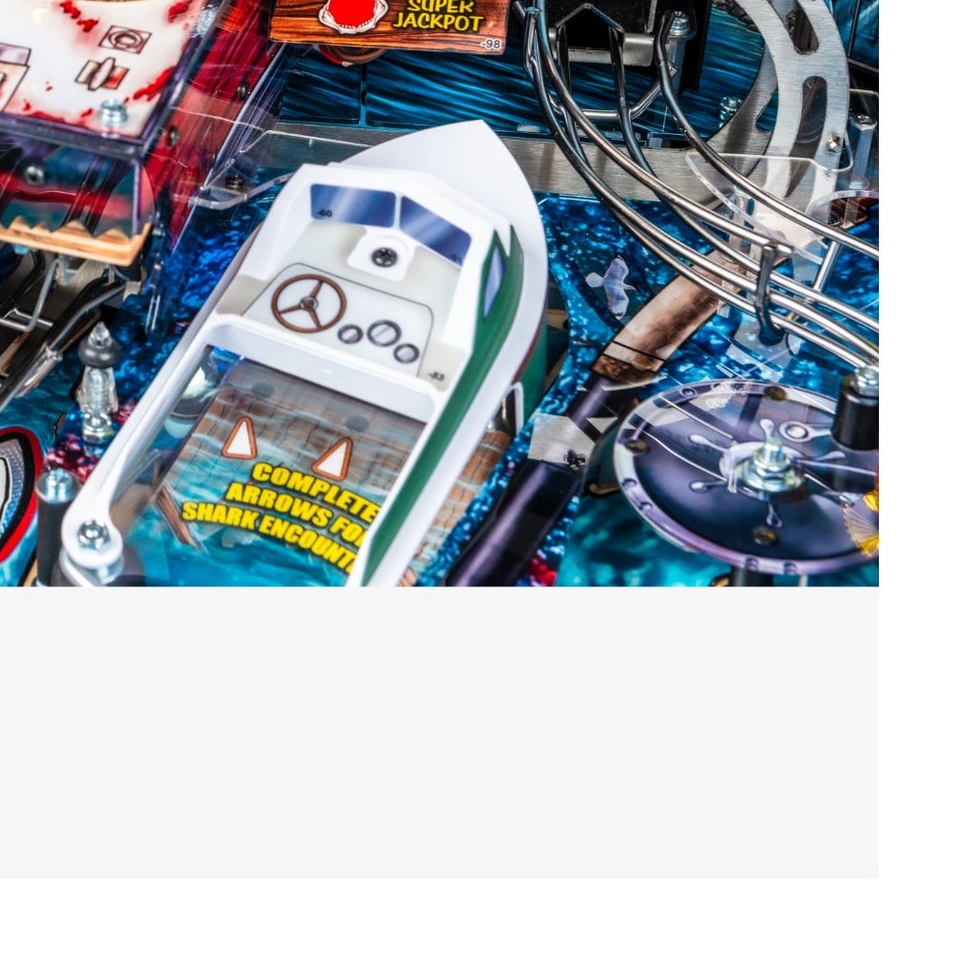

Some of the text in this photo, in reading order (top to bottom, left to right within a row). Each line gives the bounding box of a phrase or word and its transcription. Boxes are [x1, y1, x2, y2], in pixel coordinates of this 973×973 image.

[392, 12, 485, 32] JACKPOT
[481, 38, 501, 50] -98
[226, 483, 331, 526] ARROWS
[252, 462, 381, 524] COMPLETE
[181, 501, 358, 574] SHARK ENCOUNT
